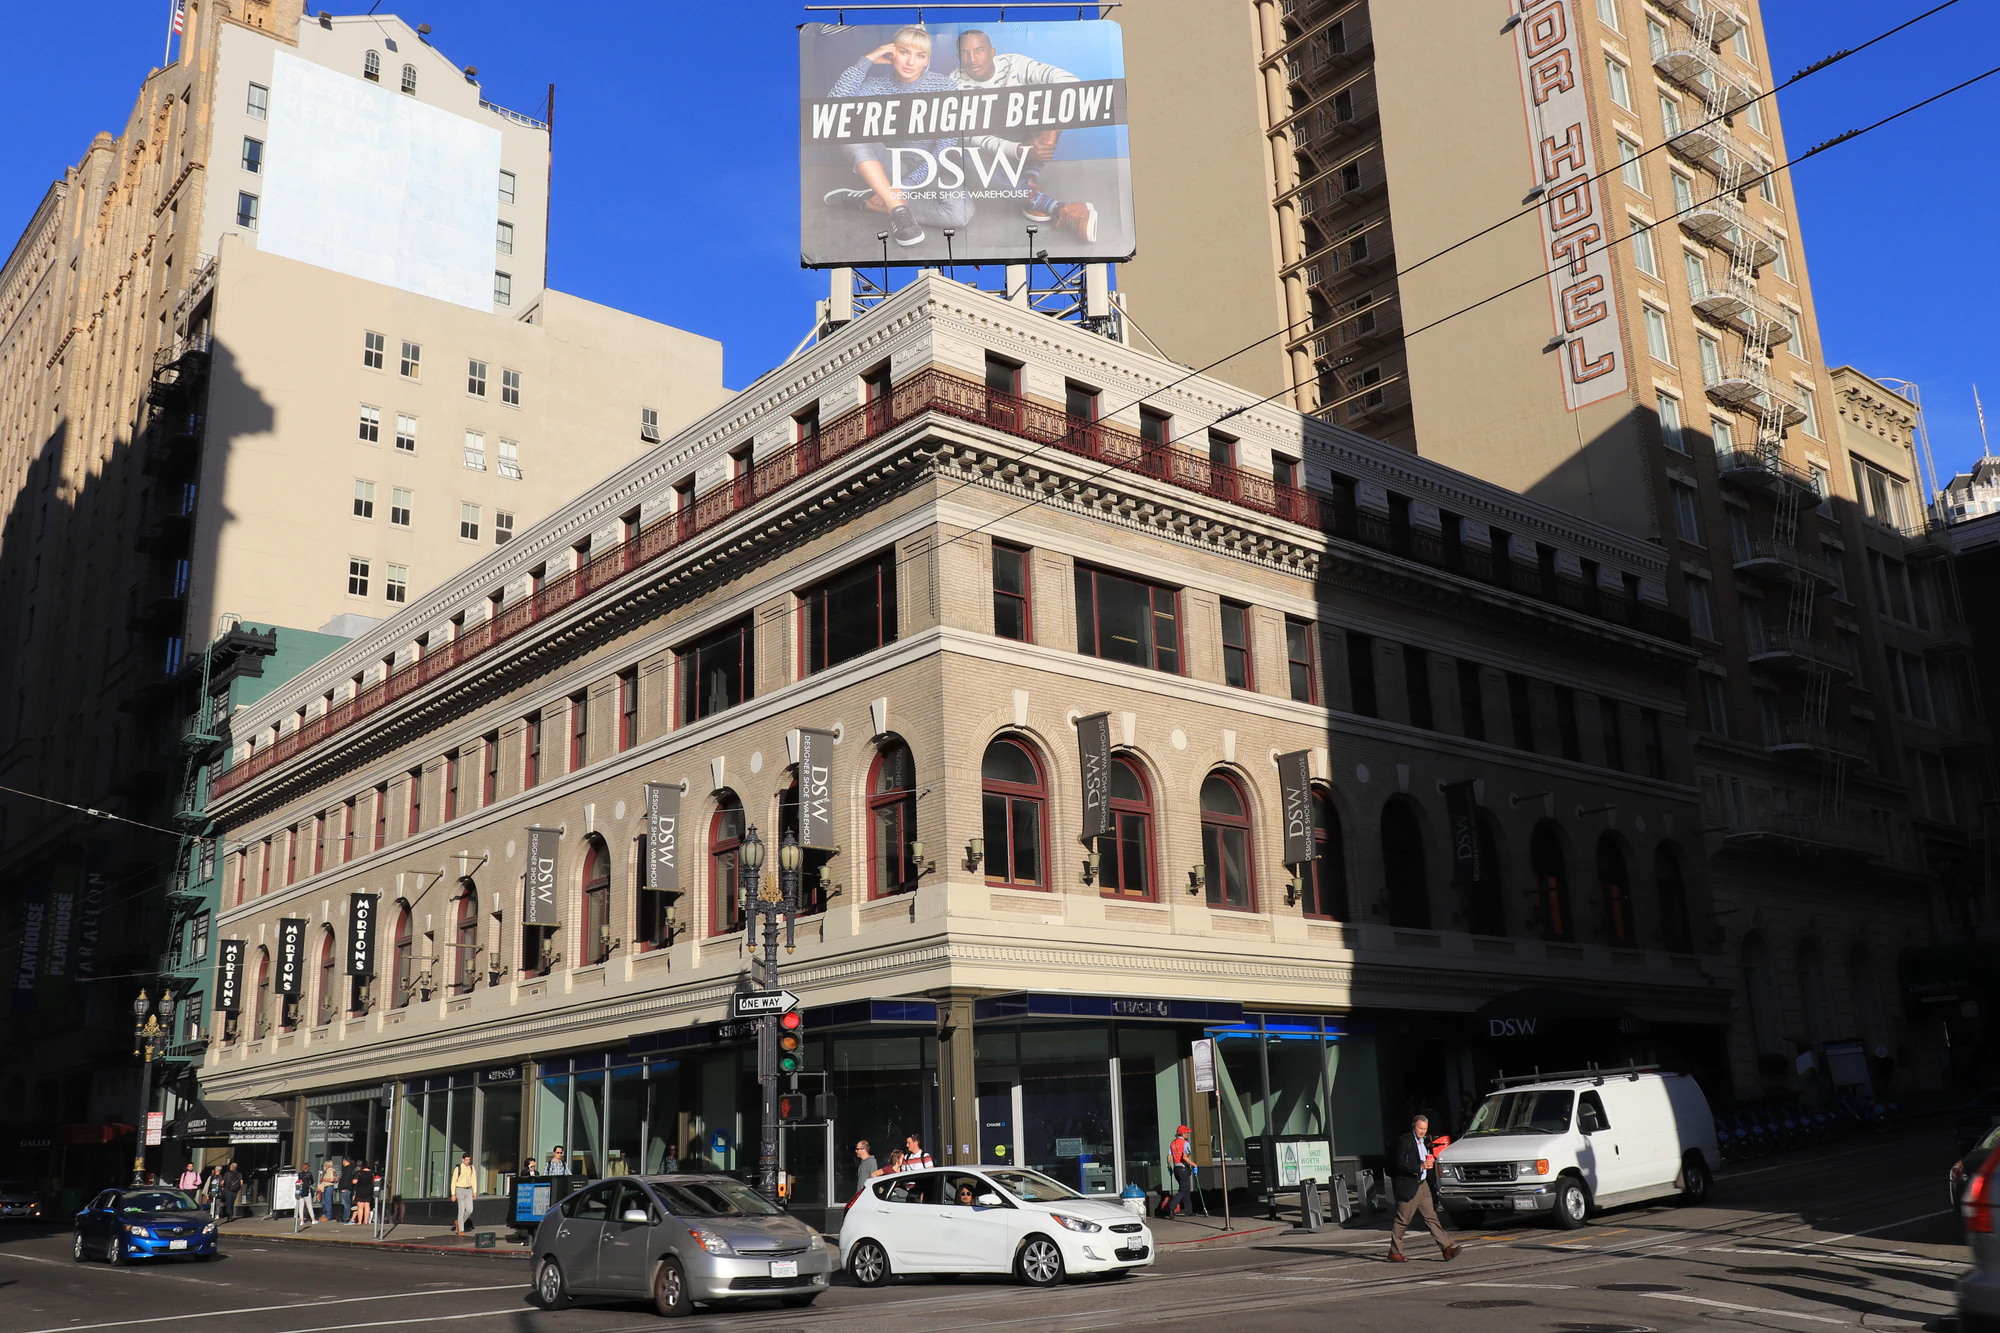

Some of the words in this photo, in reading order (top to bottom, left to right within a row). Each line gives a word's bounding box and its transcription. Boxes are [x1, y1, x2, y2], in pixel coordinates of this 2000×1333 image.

[1518, 0, 1575, 107] OR
[811, 100, 901, 139] WE'RE
[907, 93, 999, 134] RIGHT
[1005, 84, 1115, 128] BELOW!
[886, 145, 1034, 190] DSW
[889, 191, 937, 200] DESIGNER
[939, 190, 966, 200] SHOE
[1540, 122, 1615, 384] HOTEL
[803, 735, 811, 774] DESIGNER
[802, 776, 810, 798] SHOE
[811, 764, 829, 824] DSW
[1085, 752, 1100, 810] DSW
[651, 789, 659, 824] DESIGNER
[802, 800, 811, 845] WAREHOUS
[1286, 787, 1304, 839] DSW
[1303, 803, 1311, 824] SHOE
[658, 815, 675, 868] DSW
[1304, 825, 1312, 861] DESIGNER
[538, 857, 554, 904] DSW
[650, 848, 658, 888] WAREHOUS
[18, 903, 45, 990] PLAYHOUSE
[50, 893, 74, 976] PLAYHOUSE
[354, 899, 370, 971] MORTONS
[223, 945, 238, 1006] MORTONS
[283, 925, 298, 991] MORTONS
[741, 999, 759, 1009] ONE
[761, 997, 780, 1007] WAY
[1112, 1001, 1153, 1015] CHASE
[1489, 1017, 1537, 1037] DSW
[1301, 1157, 1320, 1165] WORTH
[1308, 1149, 1321, 1157] SHOT
